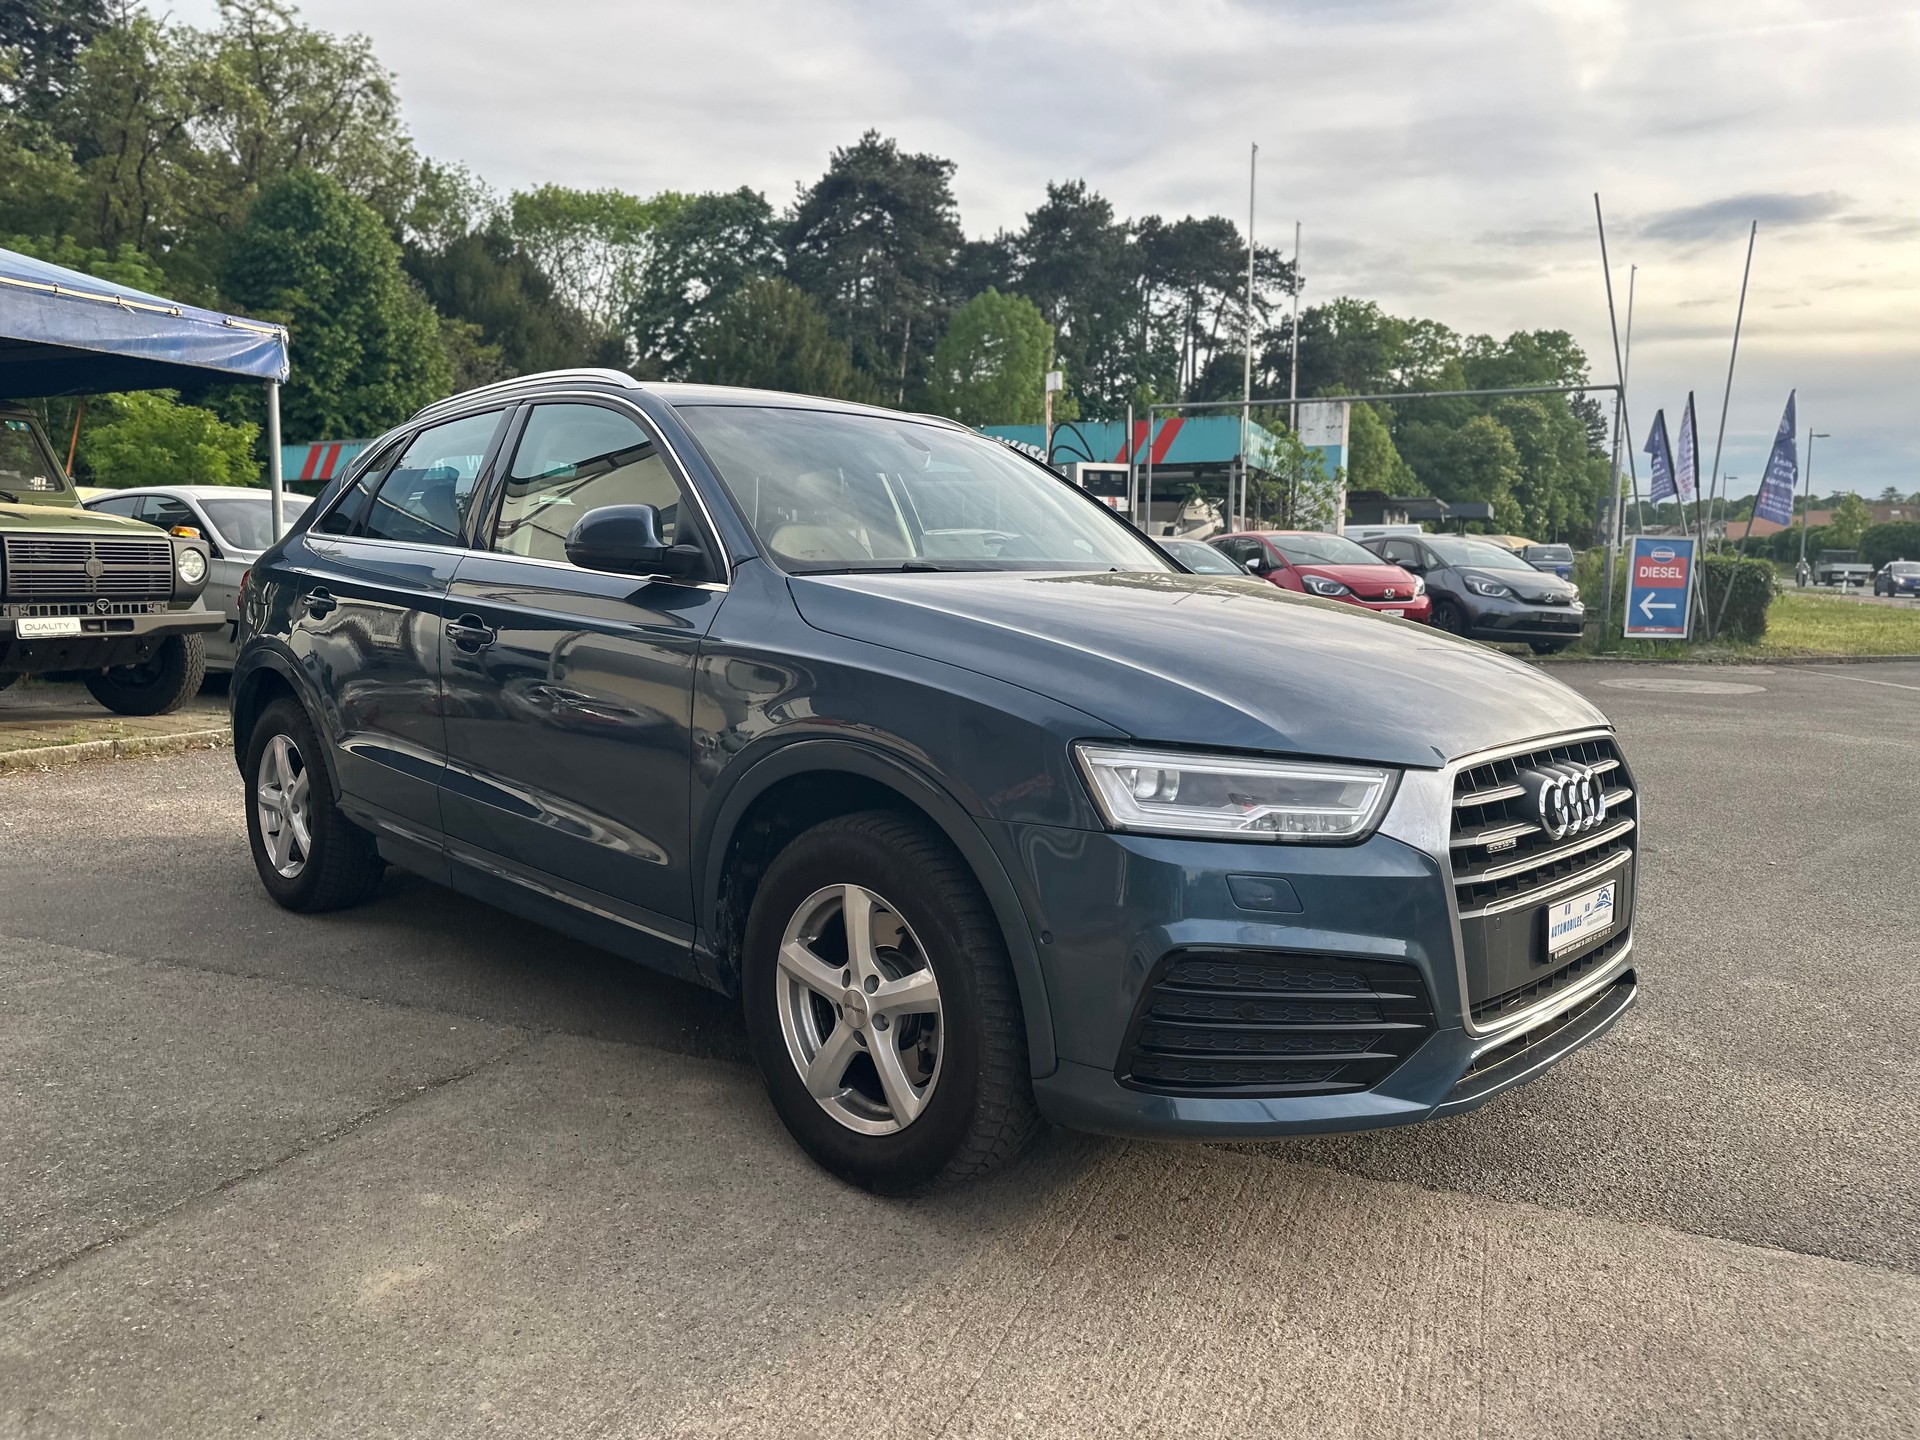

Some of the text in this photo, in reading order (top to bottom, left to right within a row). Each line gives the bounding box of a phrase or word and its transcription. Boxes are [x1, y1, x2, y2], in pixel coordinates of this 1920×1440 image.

[1061, 465, 1068, 476] 3
[1639, 566, 1683, 579] DIESEL
[1551, 914, 1583, 938] AUTOMOBILES
